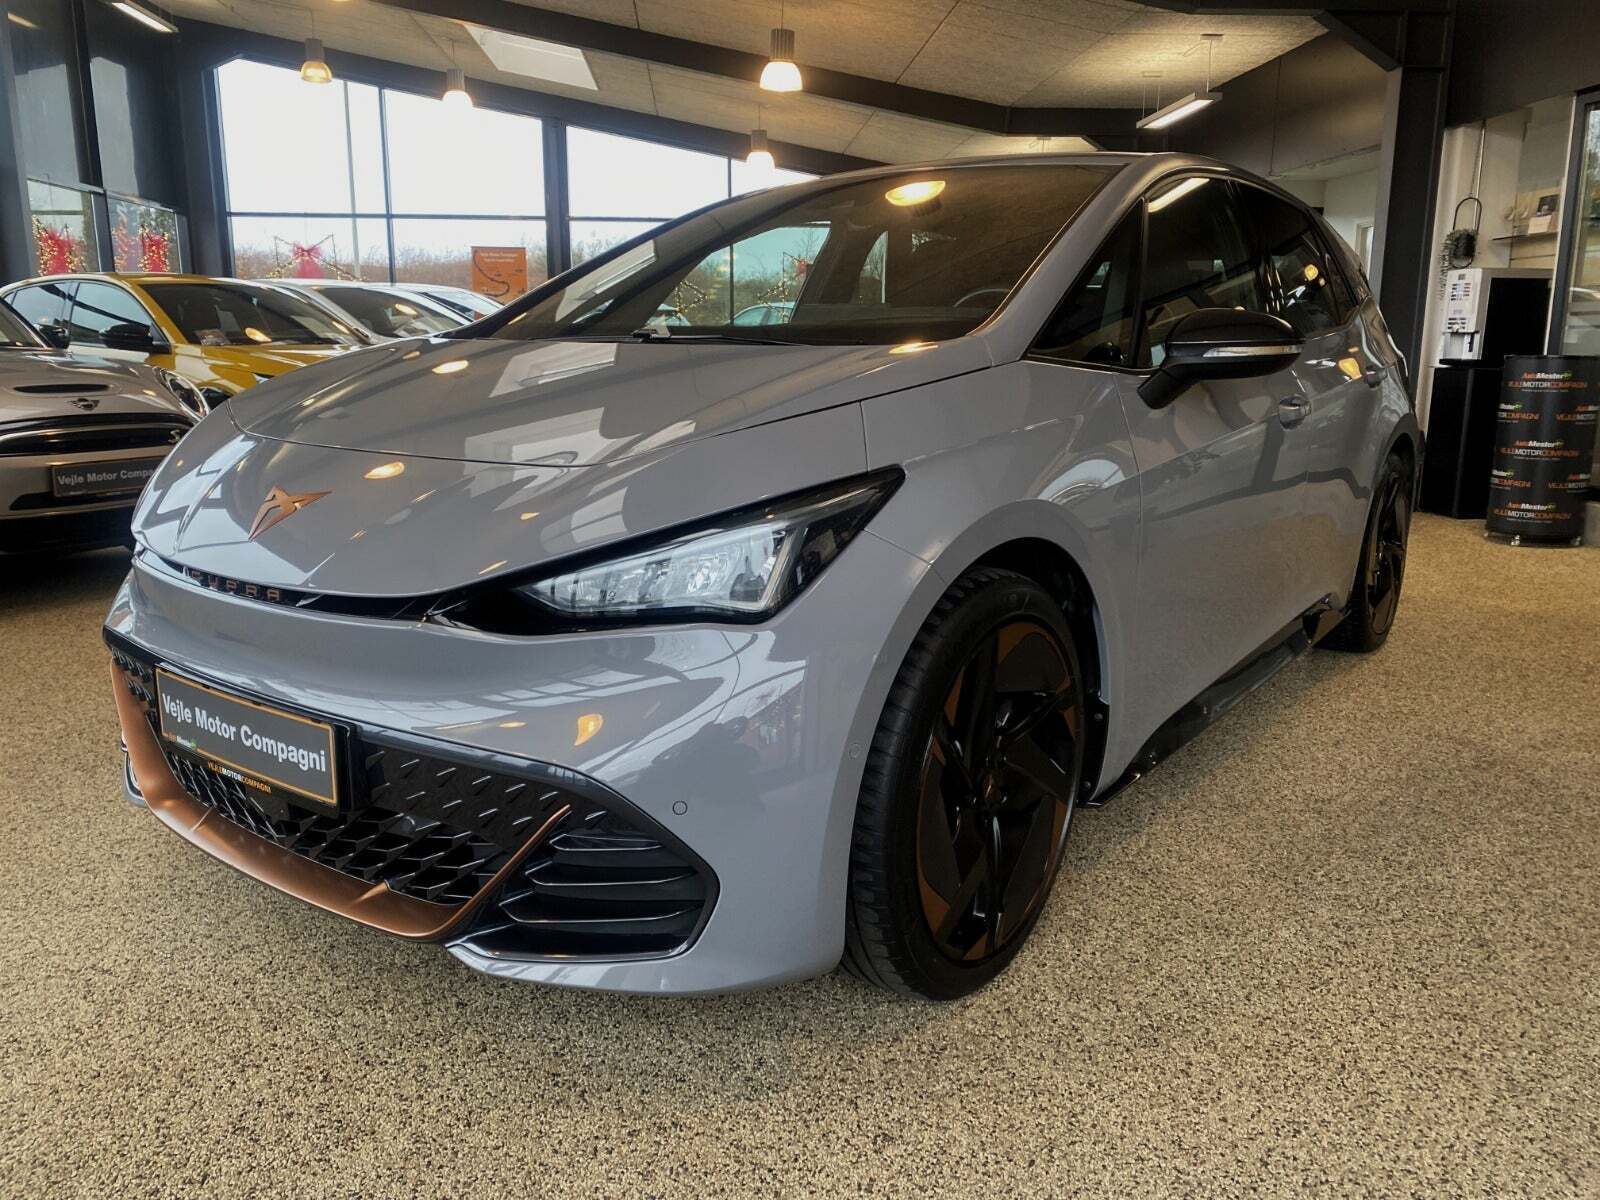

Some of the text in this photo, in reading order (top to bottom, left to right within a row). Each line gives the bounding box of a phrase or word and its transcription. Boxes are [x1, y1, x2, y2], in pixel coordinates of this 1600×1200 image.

[58, 475, 84, 486] Vejle
[87, 472, 118, 482] Motor
[162, 693, 192, 724] Vejle
[194, 710, 237, 742] Motor
[240, 724, 326, 773] Compagni
